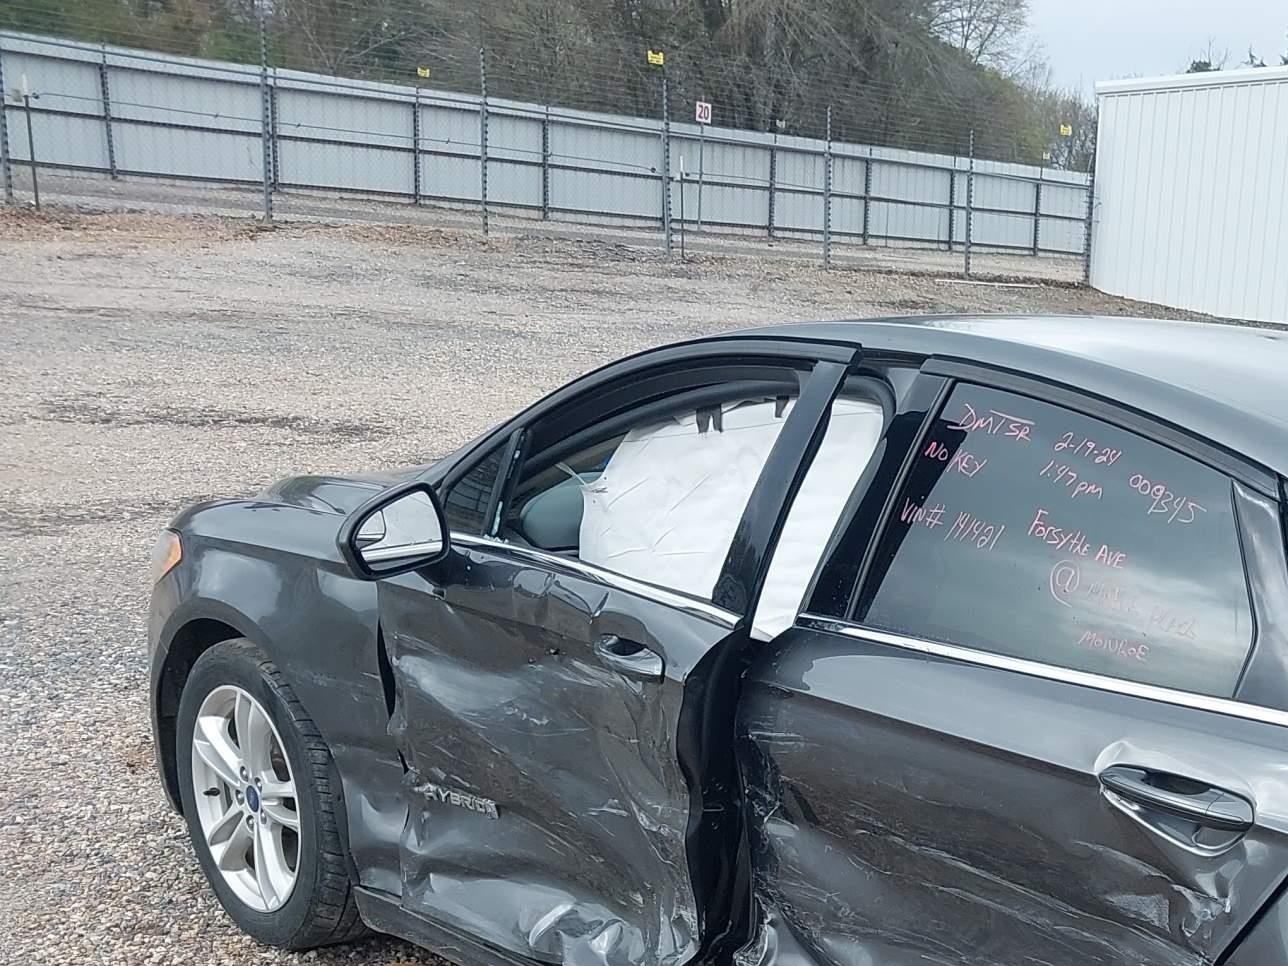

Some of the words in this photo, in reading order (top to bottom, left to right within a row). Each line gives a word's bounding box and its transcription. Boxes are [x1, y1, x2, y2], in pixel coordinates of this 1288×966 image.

[698, 104, 710, 120] 20
[924, 441, 949, 461] NO
[946, 448, 988, 477] KEY
[1054, 432, 1122, 466] 2-19-24
[1039, 459, 1077, 487] 1:47
[900, 497, 946, 529] VIN#
[1129, 474, 1207, 524] 009345
[1095, 544, 1127, 569] AVE
